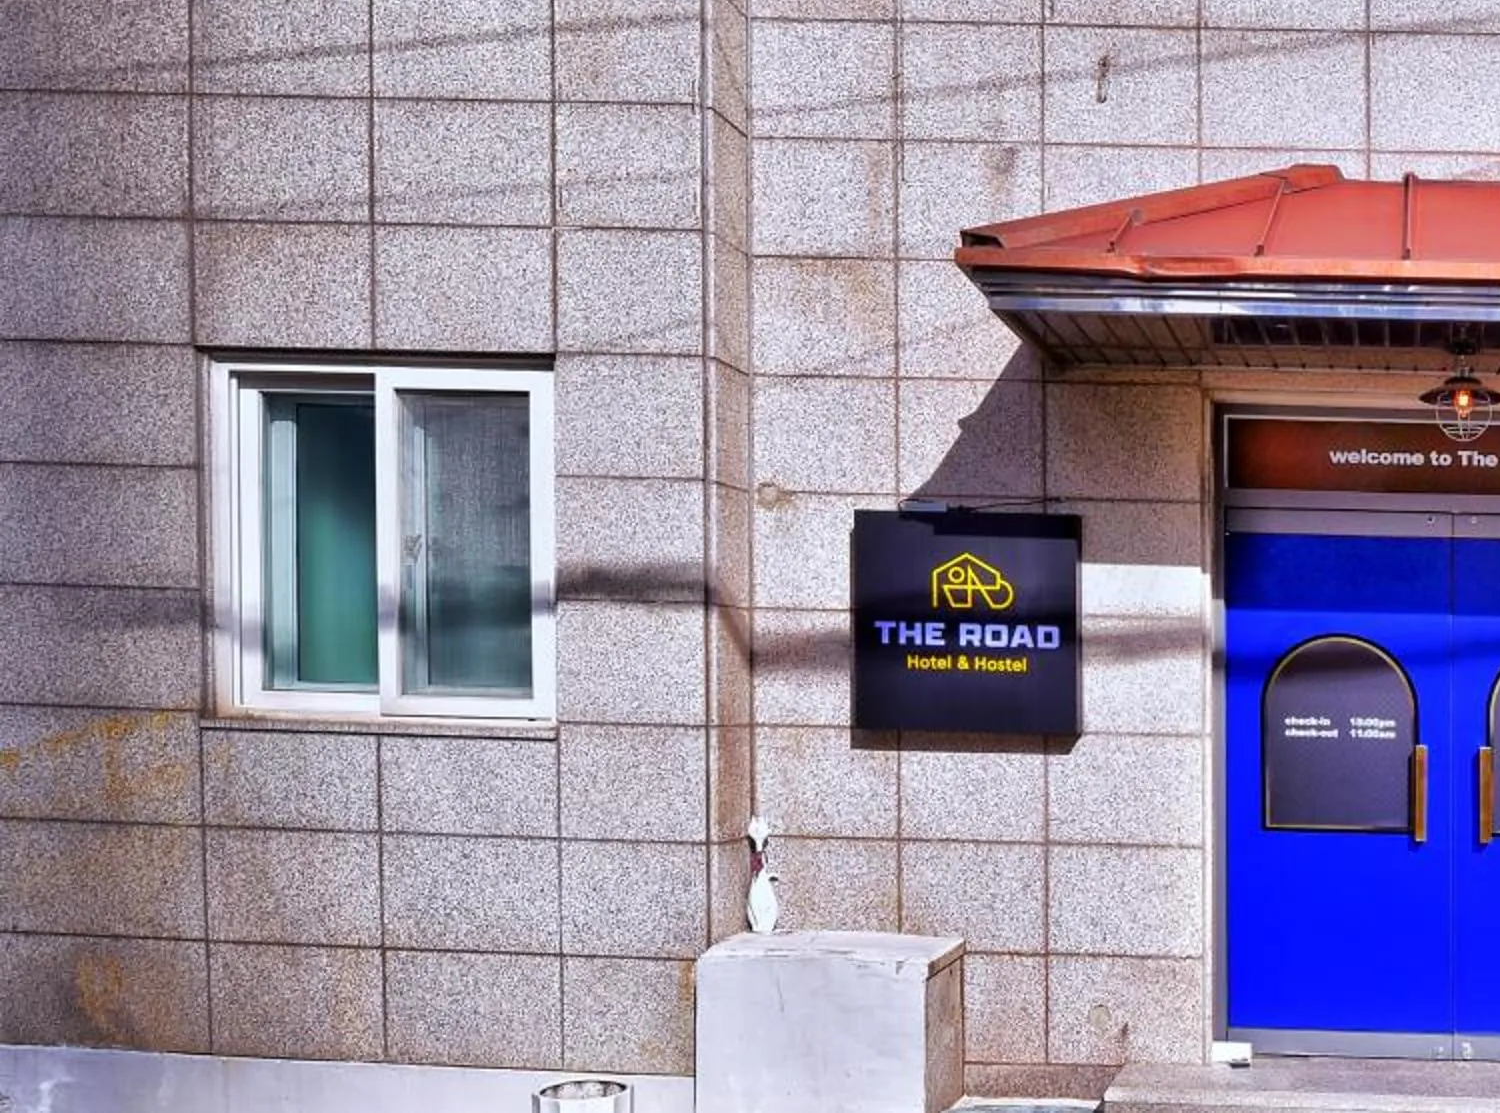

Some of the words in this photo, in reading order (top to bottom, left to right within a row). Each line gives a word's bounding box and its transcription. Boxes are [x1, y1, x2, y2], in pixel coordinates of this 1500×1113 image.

[1330, 449, 1426, 467] welcome
[1430, 451, 1453, 467] to
[1458, 451, 1500, 468] The
[874, 621, 947, 647] THE
[959, 623, 1061, 650] ROAD
[907, 655, 952, 671] Hotel
[956, 656, 971, 672] &
[974, 657, 1028, 673] Hostel
